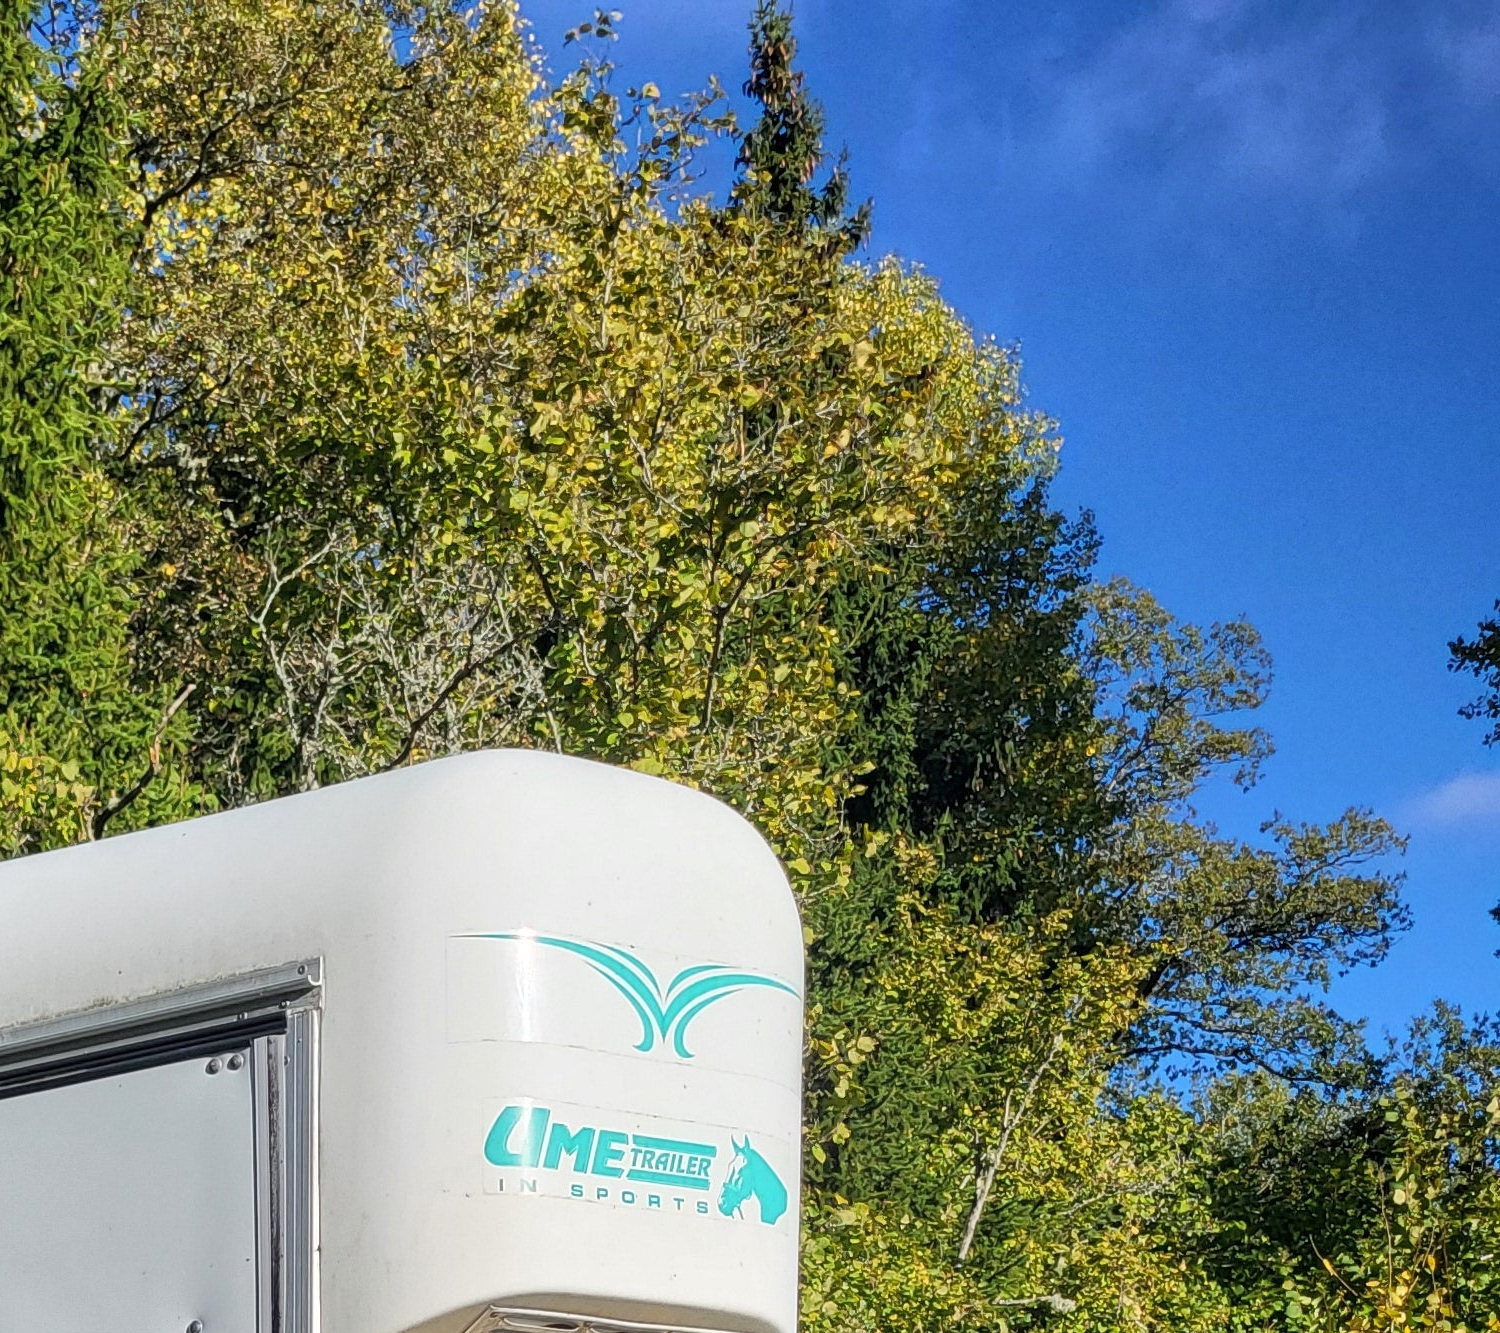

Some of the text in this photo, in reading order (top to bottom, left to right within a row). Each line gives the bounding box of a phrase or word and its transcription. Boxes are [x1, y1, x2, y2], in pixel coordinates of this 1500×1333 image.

[630, 1148, 712, 1178] TRAILER
[499, 1178, 709, 1214] IN SPORTS
